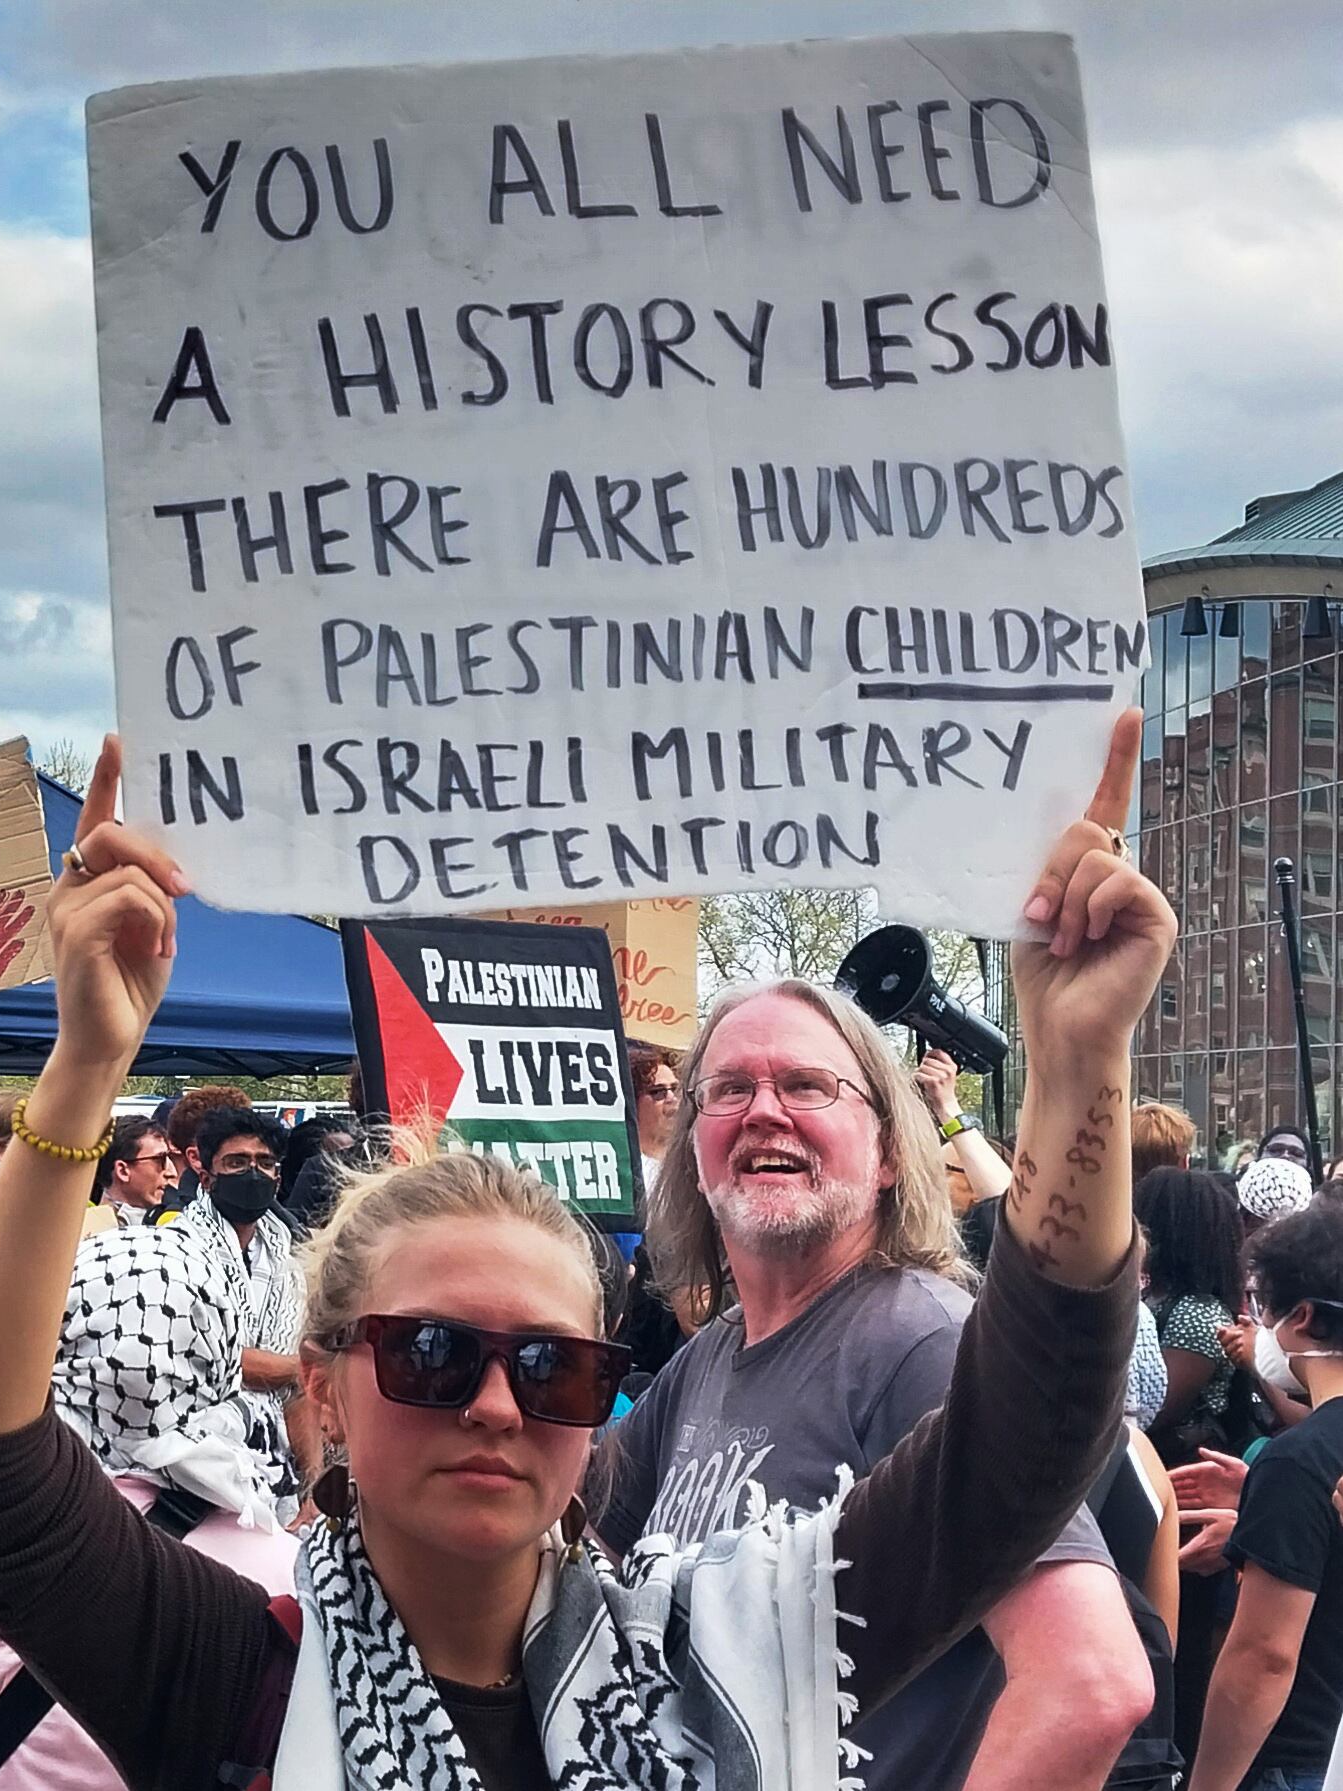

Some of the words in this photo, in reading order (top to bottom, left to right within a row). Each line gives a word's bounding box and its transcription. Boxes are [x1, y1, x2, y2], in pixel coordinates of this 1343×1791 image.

[178, 139, 394, 241] YOU
[489, 113, 722, 224] ALL
[782, 98, 1051, 211] NEED
[153, 327, 231, 424] A
[318, 298, 774, 417] HISTORY
[822, 292, 1111, 389] LESSON
[154, 473, 471, 592] THERE
[536, 470, 695, 567] ARE
[731, 457, 1125, 551] HUNDREDS
[165, 626, 262, 720] OF
[321, 606, 815, 708] PALESTINIAN
[845, 606, 1149, 677] CHILDREN
[159, 750, 245, 824] IN
[297, 737, 588, 816] ISRAELI
[632, 719, 1032, 800] MILITARY
[358, 811, 880, 904] DETENTION
[421, 948, 603, 1010] PALESTINIAN
[468, 1039, 619, 1107] LIVES
[448, 1141, 621, 1200] TTER
